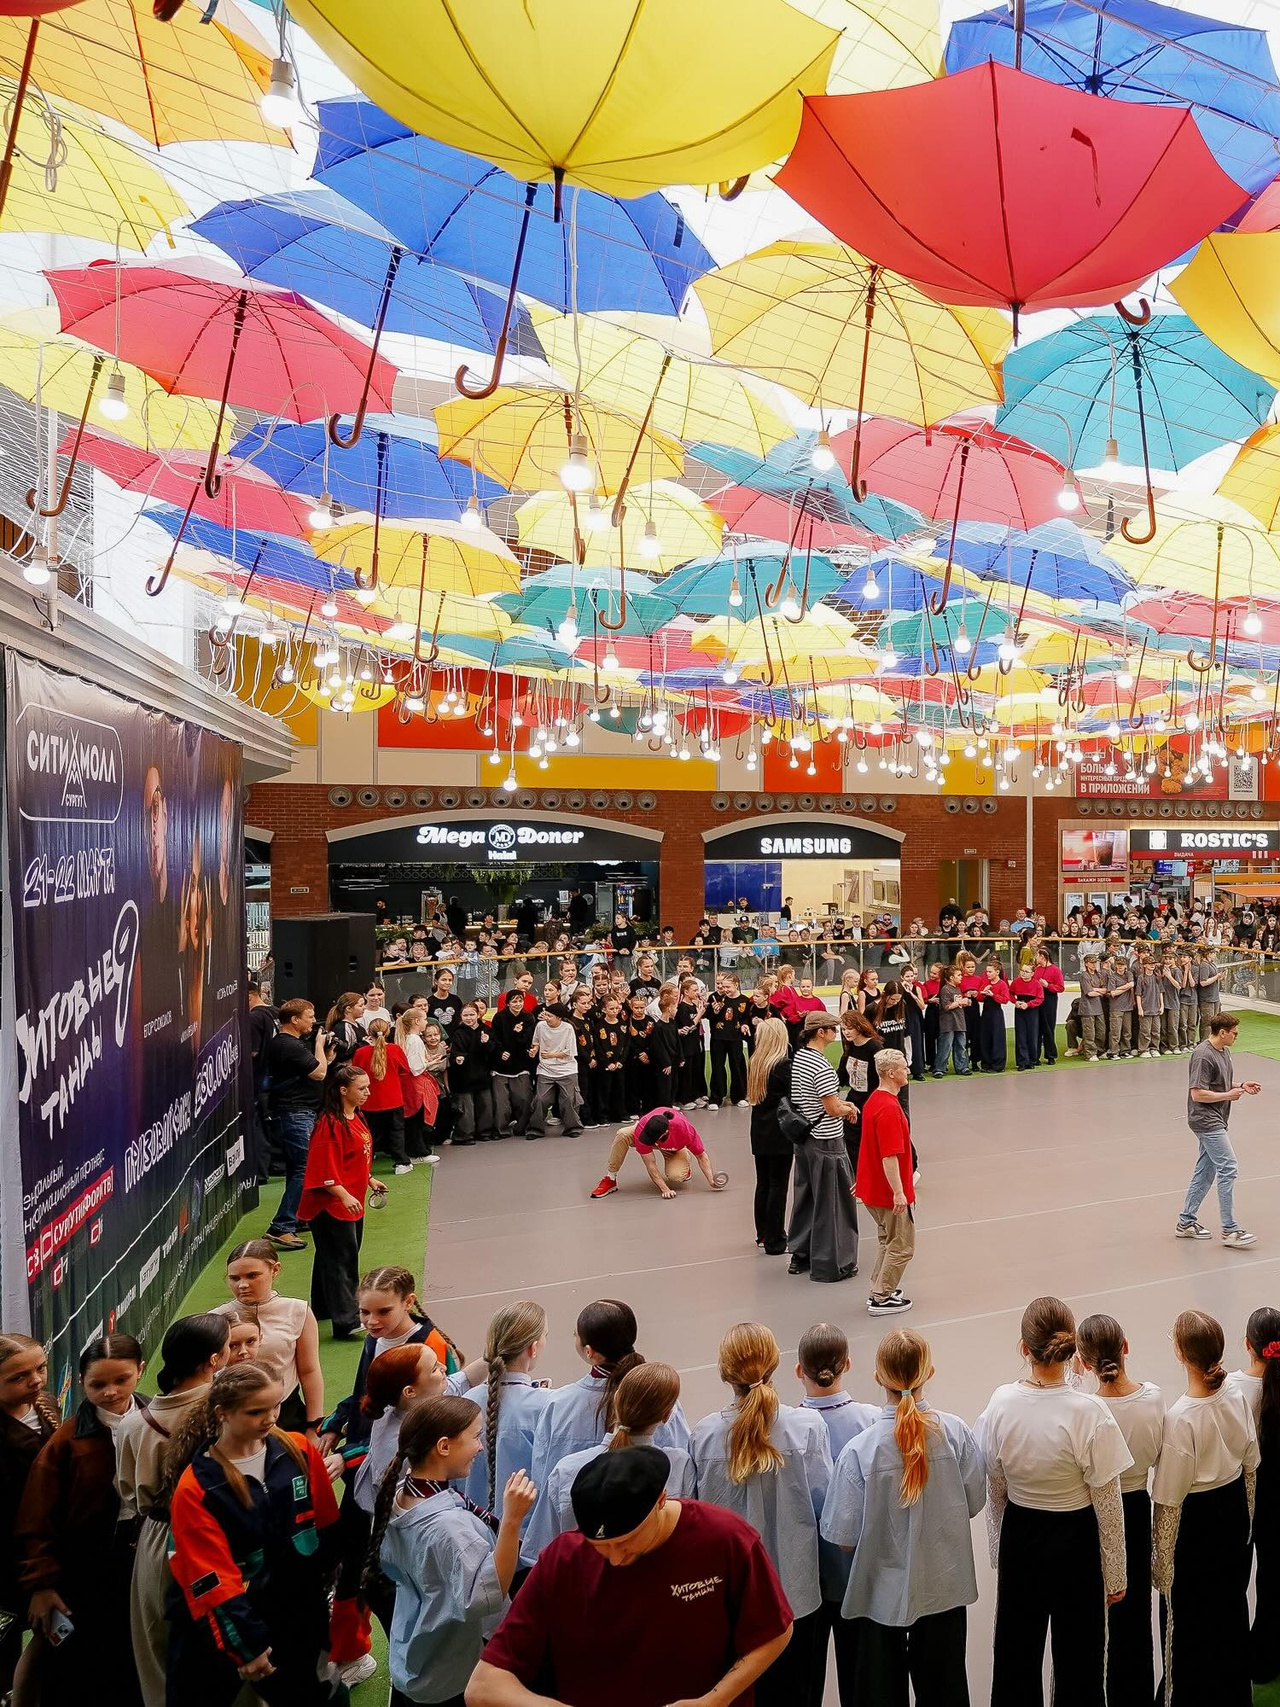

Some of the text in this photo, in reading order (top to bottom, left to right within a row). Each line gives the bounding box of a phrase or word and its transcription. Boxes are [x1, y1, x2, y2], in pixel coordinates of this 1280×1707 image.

[1081, 763, 1118, 774] БОЛЬЕ
[1081, 783, 1150, 794] В ПРИЛОЖЕНИИ
[65, 793, 83, 807] СУРГУТ
[416, 826, 486, 848] Mega
[517, 827, 584, 844] Doner
[1180, 832, 1269, 848] ROSTIC'S
[760, 837, 852, 854] SAMSUNG
[671, 1576, 723, 1597] ХИТОВЫЕ
